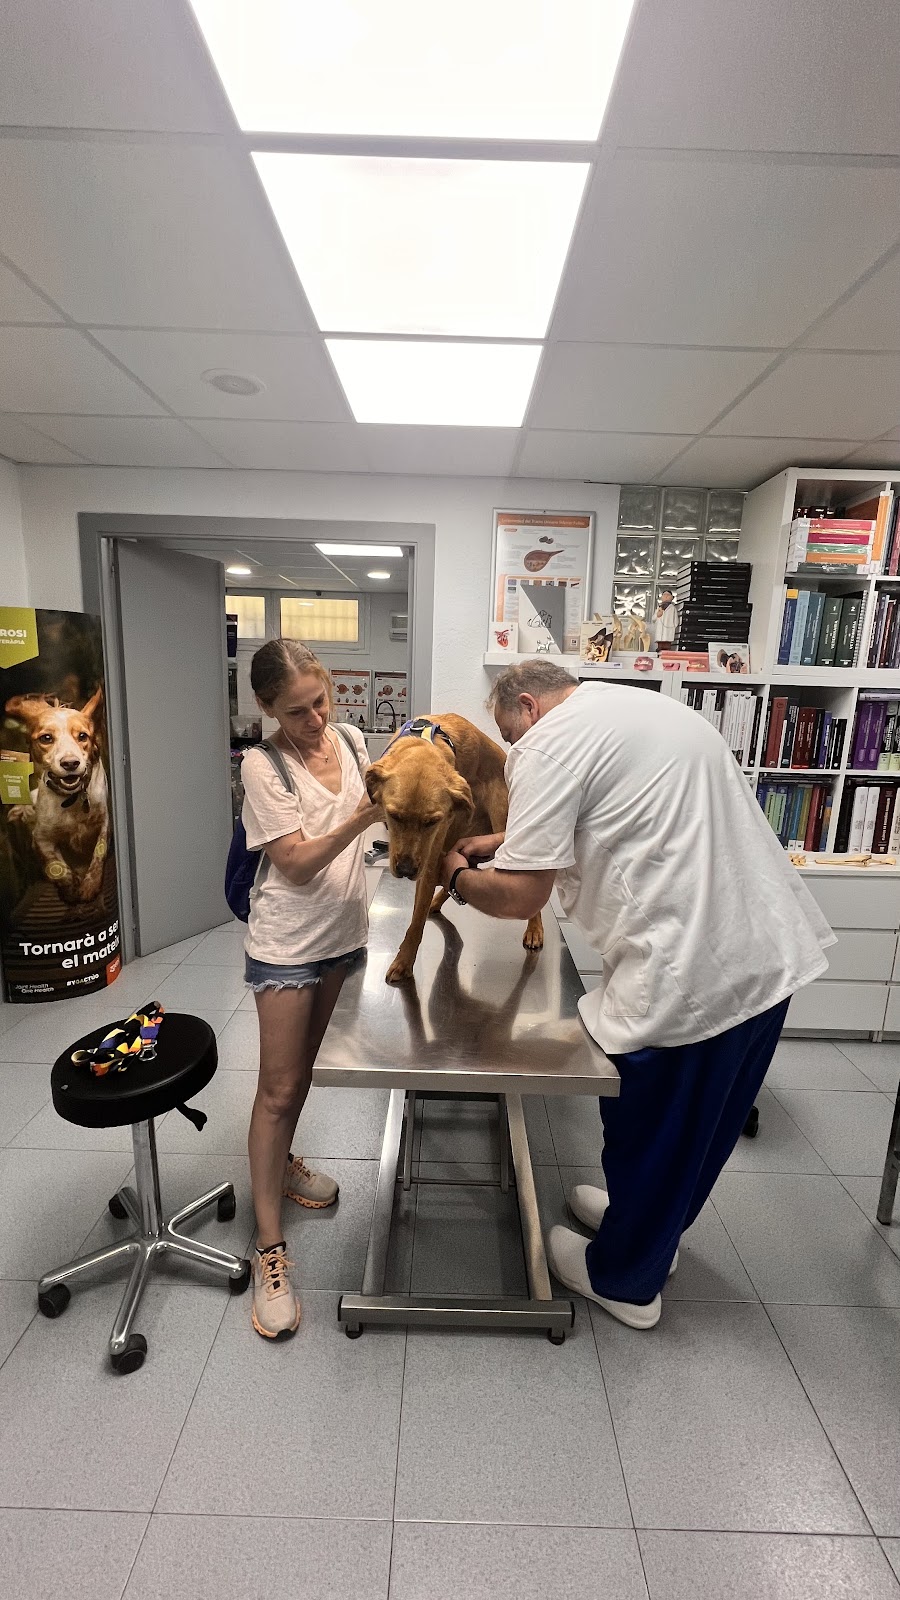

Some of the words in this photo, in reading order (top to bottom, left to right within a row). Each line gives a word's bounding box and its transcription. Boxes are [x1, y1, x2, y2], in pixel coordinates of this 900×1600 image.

[0, 629, 27, 638] ROSI
[19, 933, 95, 956] Tornarà
[98, 930, 107, 942] a
[61, 954, 79, 969] el
